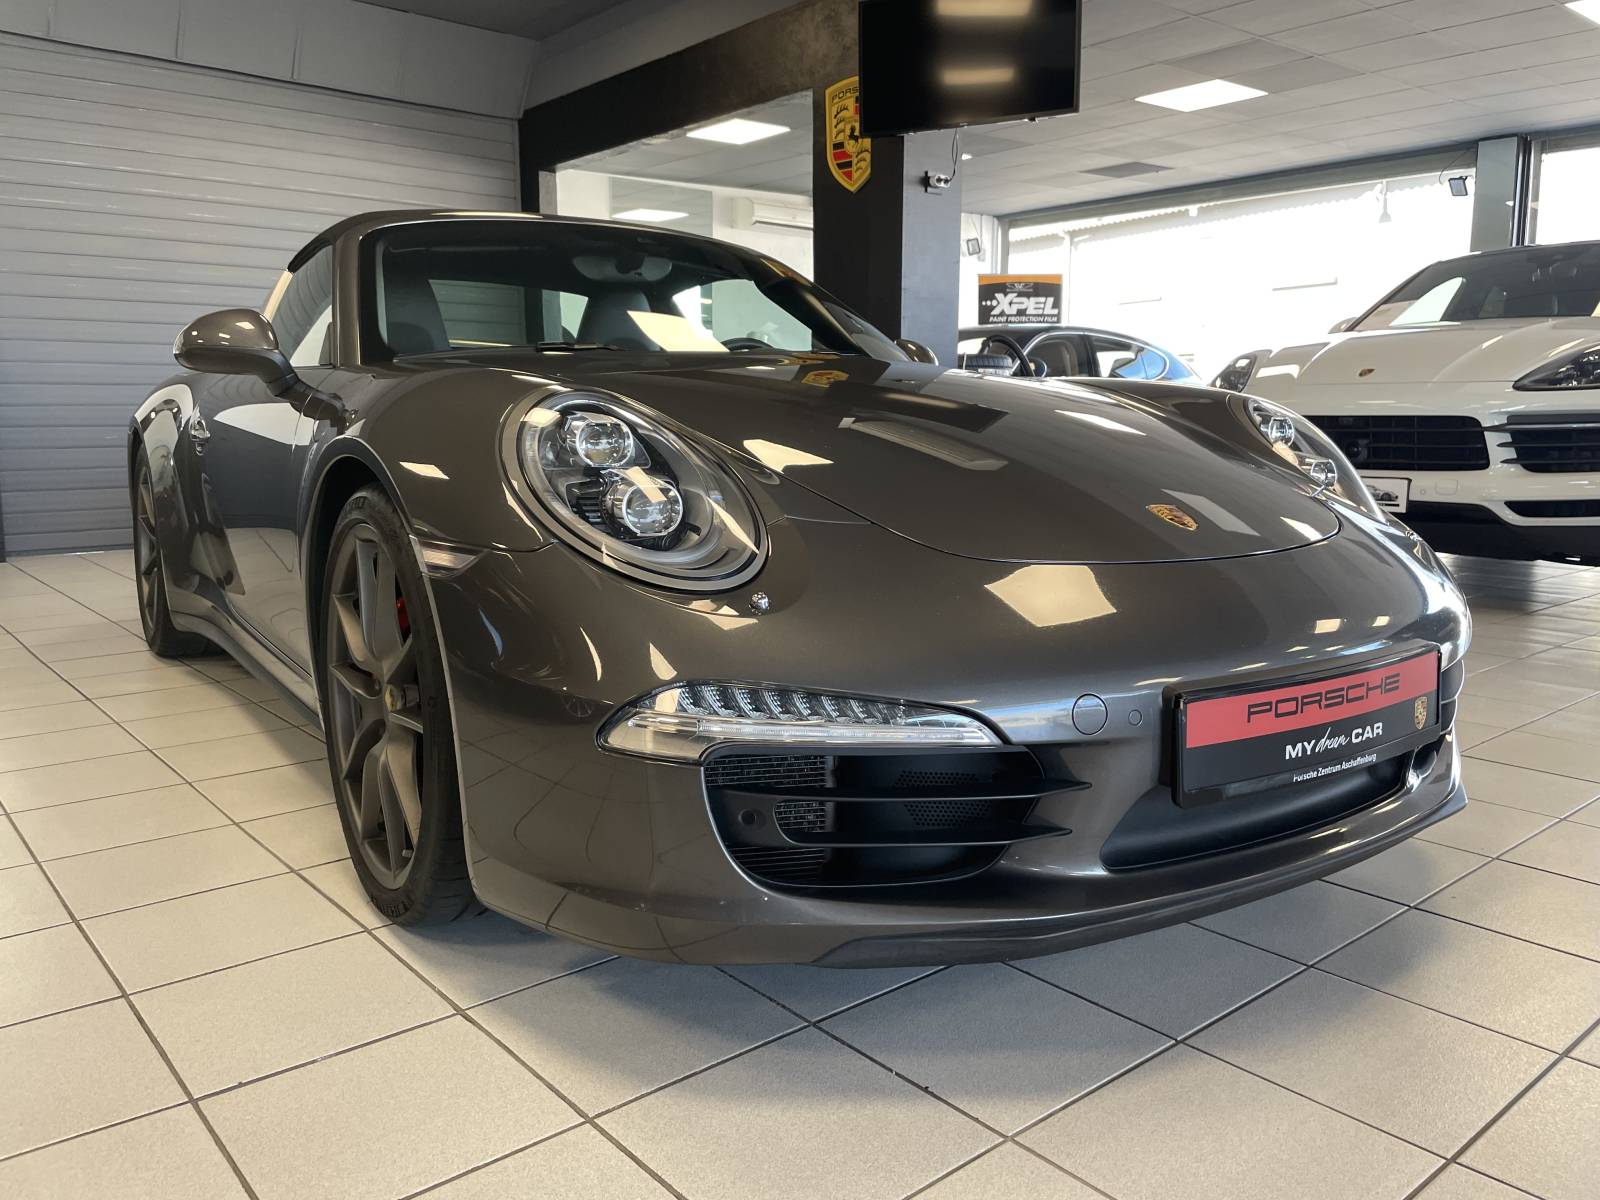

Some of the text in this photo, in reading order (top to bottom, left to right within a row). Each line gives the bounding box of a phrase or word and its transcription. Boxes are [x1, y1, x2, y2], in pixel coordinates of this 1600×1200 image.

[832, 86, 860, 104] PORS
[990, 292, 1059, 315] XPEL
[989, 315, 1058, 323] PAINT PROTECTION FILM
[1246, 672, 1400, 723] PORSCHE
[1285, 722, 1383, 760] MY dream CAR
[1293, 753, 1377, 783] Porsche Zentrum Aschaffenburg
